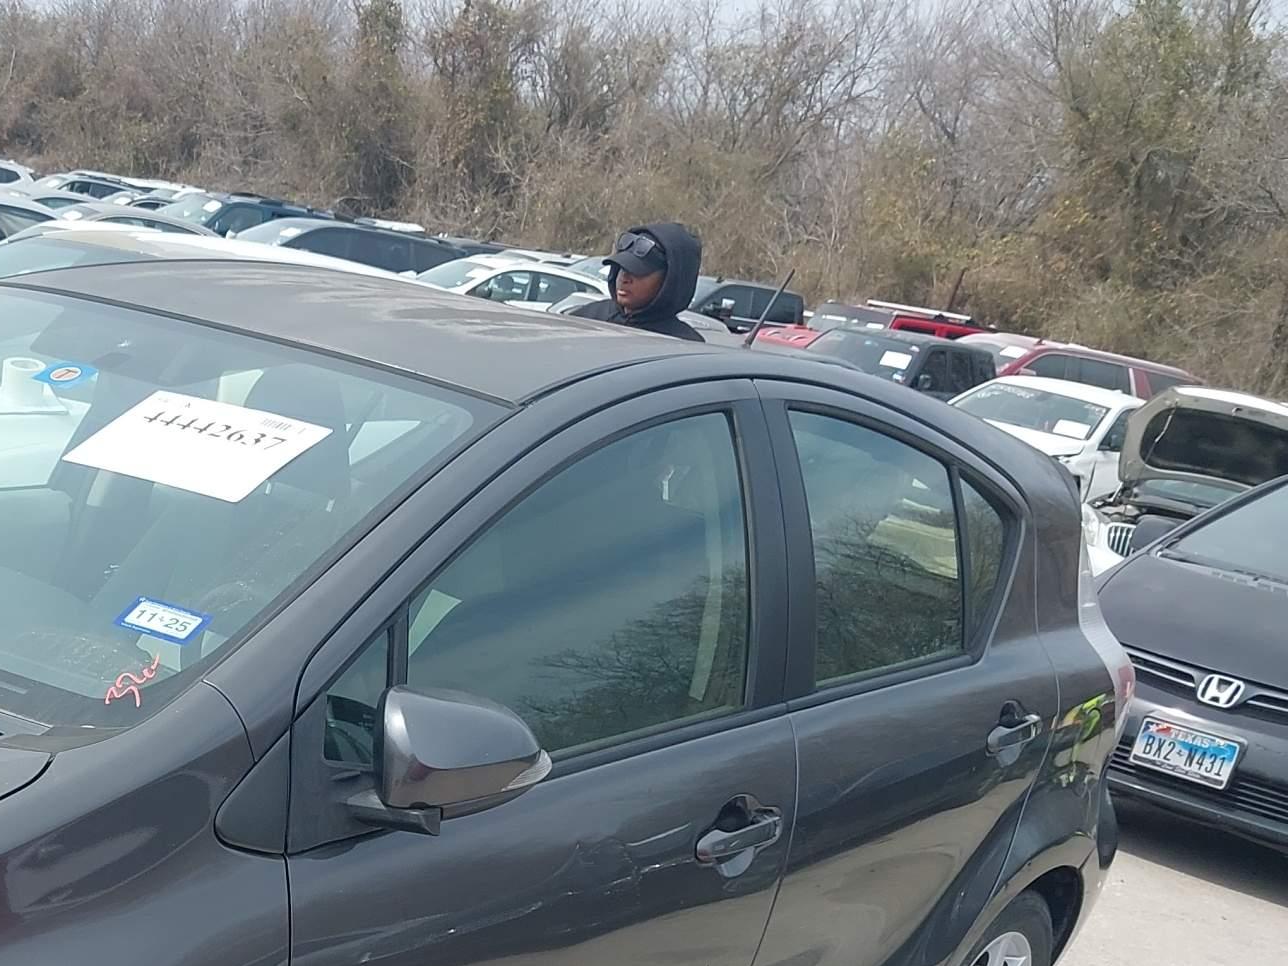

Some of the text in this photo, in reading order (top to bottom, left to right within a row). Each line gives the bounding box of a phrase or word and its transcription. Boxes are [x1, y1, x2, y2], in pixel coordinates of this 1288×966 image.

[143, 410, 287, 450] 44442637
[1143, 735, 1176, 761] BX2
[1183, 746, 1226, 777] N431
[1171, 729, 1210, 748] TEXAS
